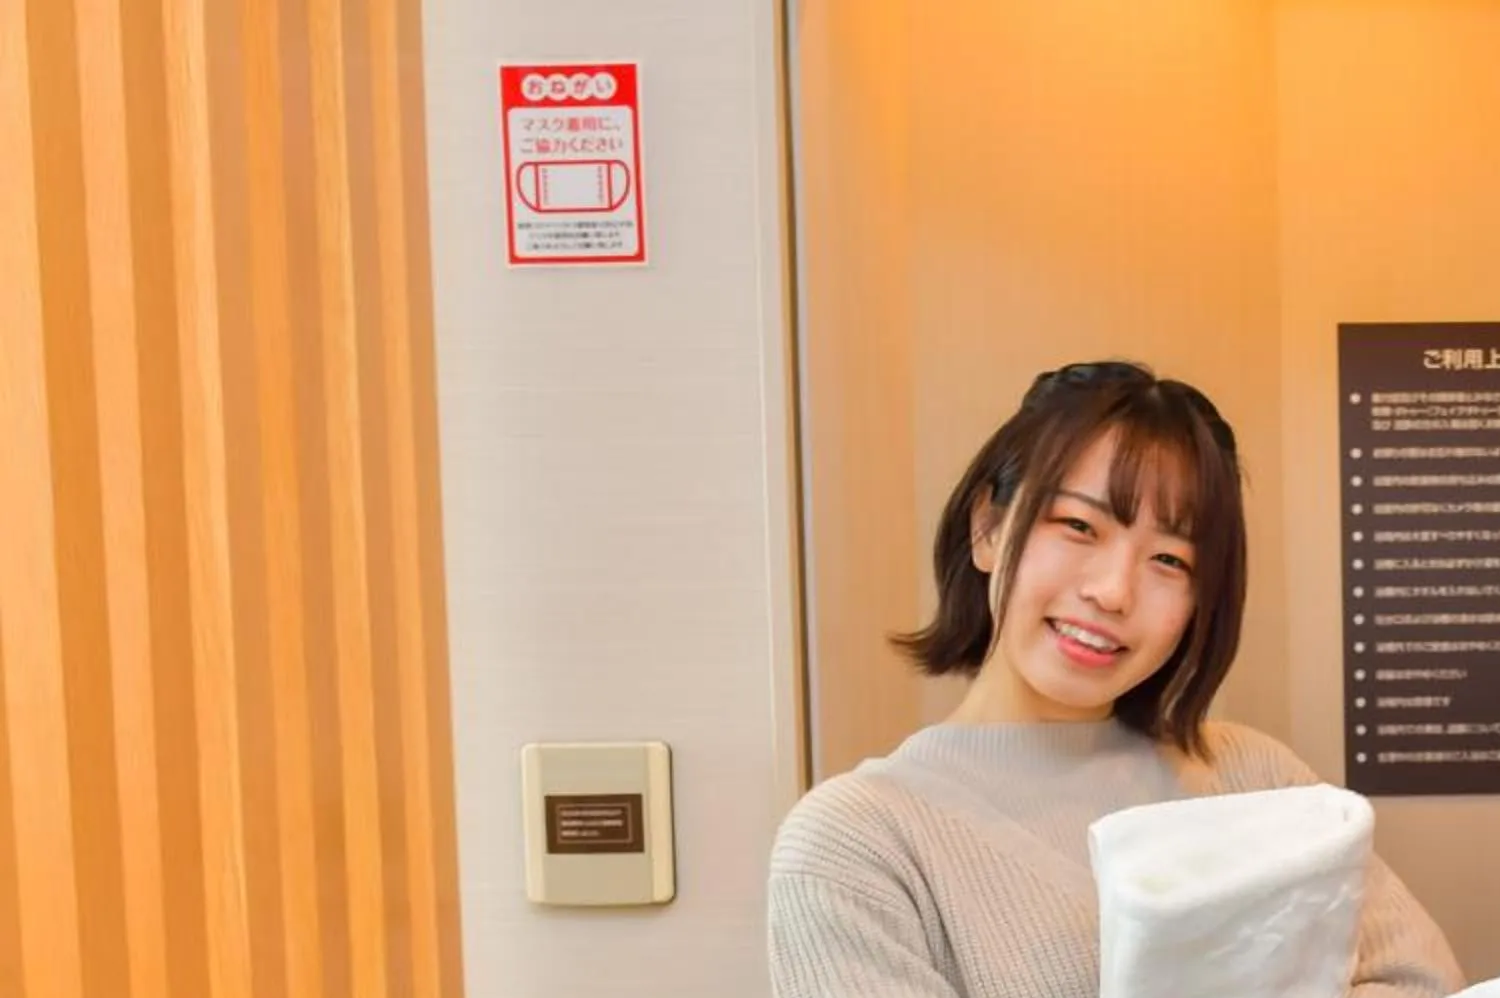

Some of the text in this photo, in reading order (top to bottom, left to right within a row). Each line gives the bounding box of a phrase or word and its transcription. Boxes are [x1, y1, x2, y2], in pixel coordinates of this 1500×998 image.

[527, 79, 612, 96] おねがい
[520, 136, 623, 155] ご協力ください
